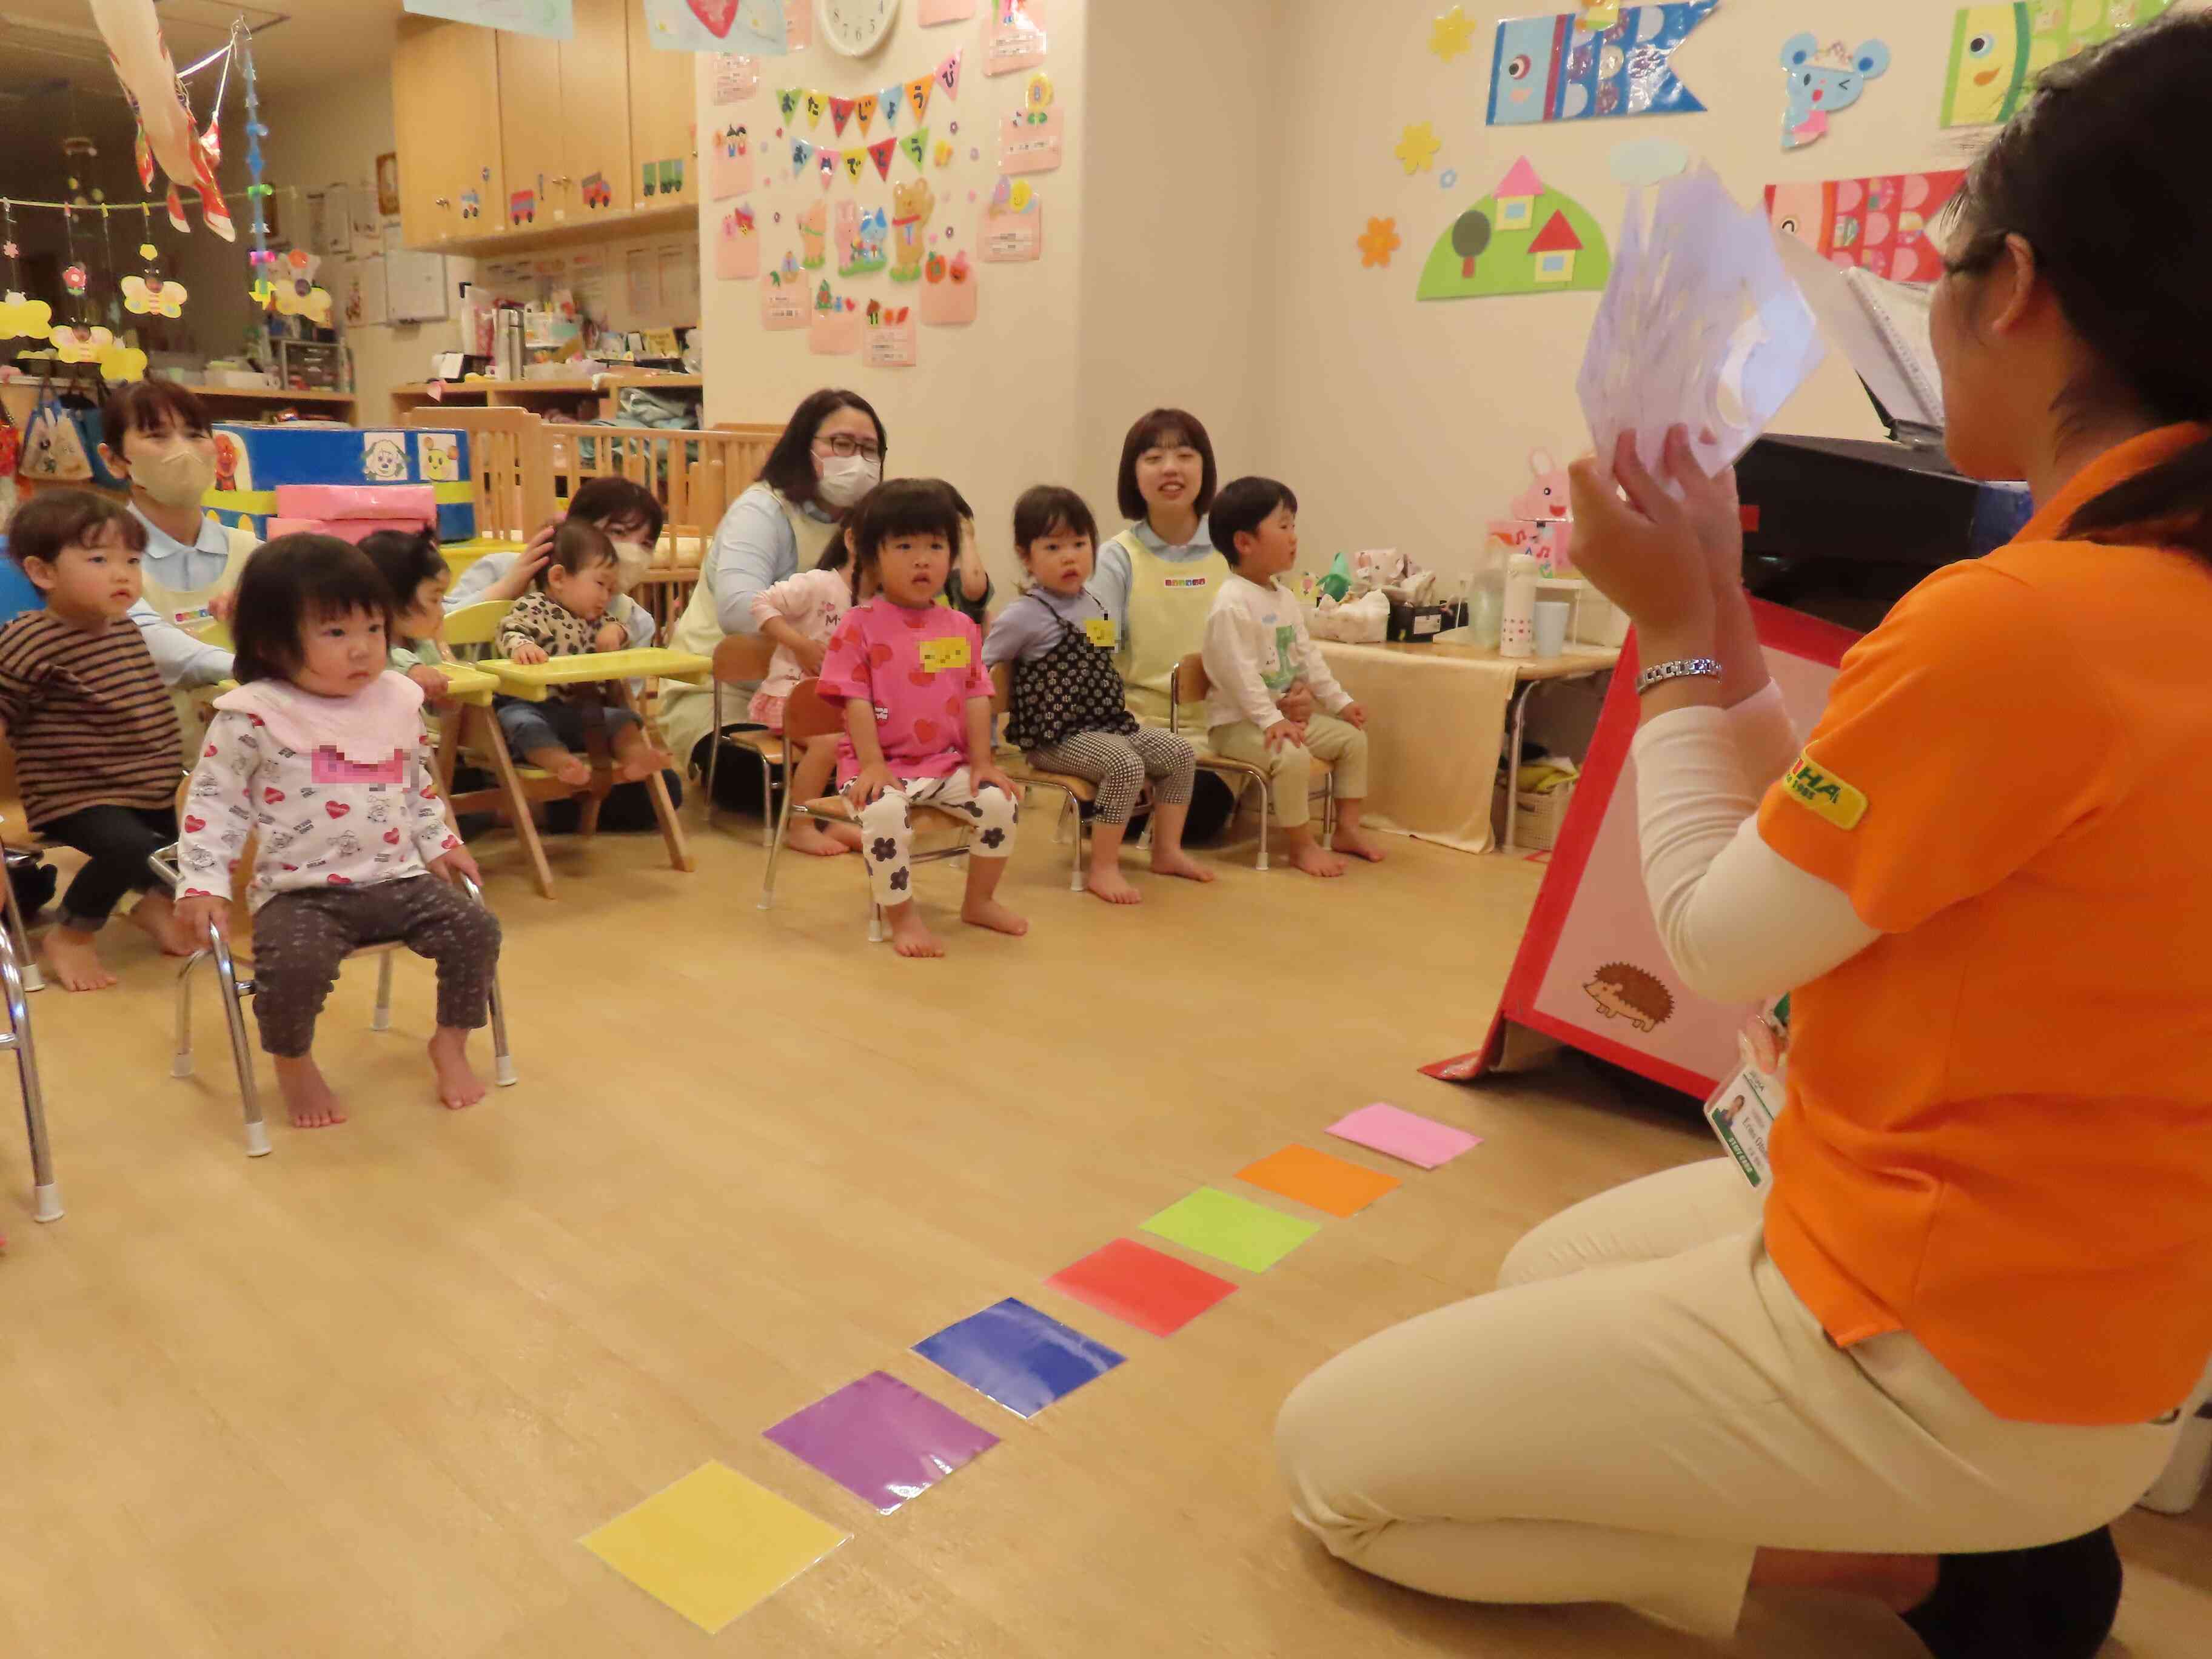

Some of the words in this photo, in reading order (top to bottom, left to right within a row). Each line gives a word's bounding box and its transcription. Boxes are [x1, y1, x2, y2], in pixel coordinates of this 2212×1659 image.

[834, 8, 840, 23] 8
[843, 22, 849, 38] 7
[855, 27, 862, 41] 6
[868, 19, 875, 34] 5
[782, 59, 955, 122] おたんじょうび
[793, 138, 922, 175] おめでとう
[825, 614, 841, 626] M
